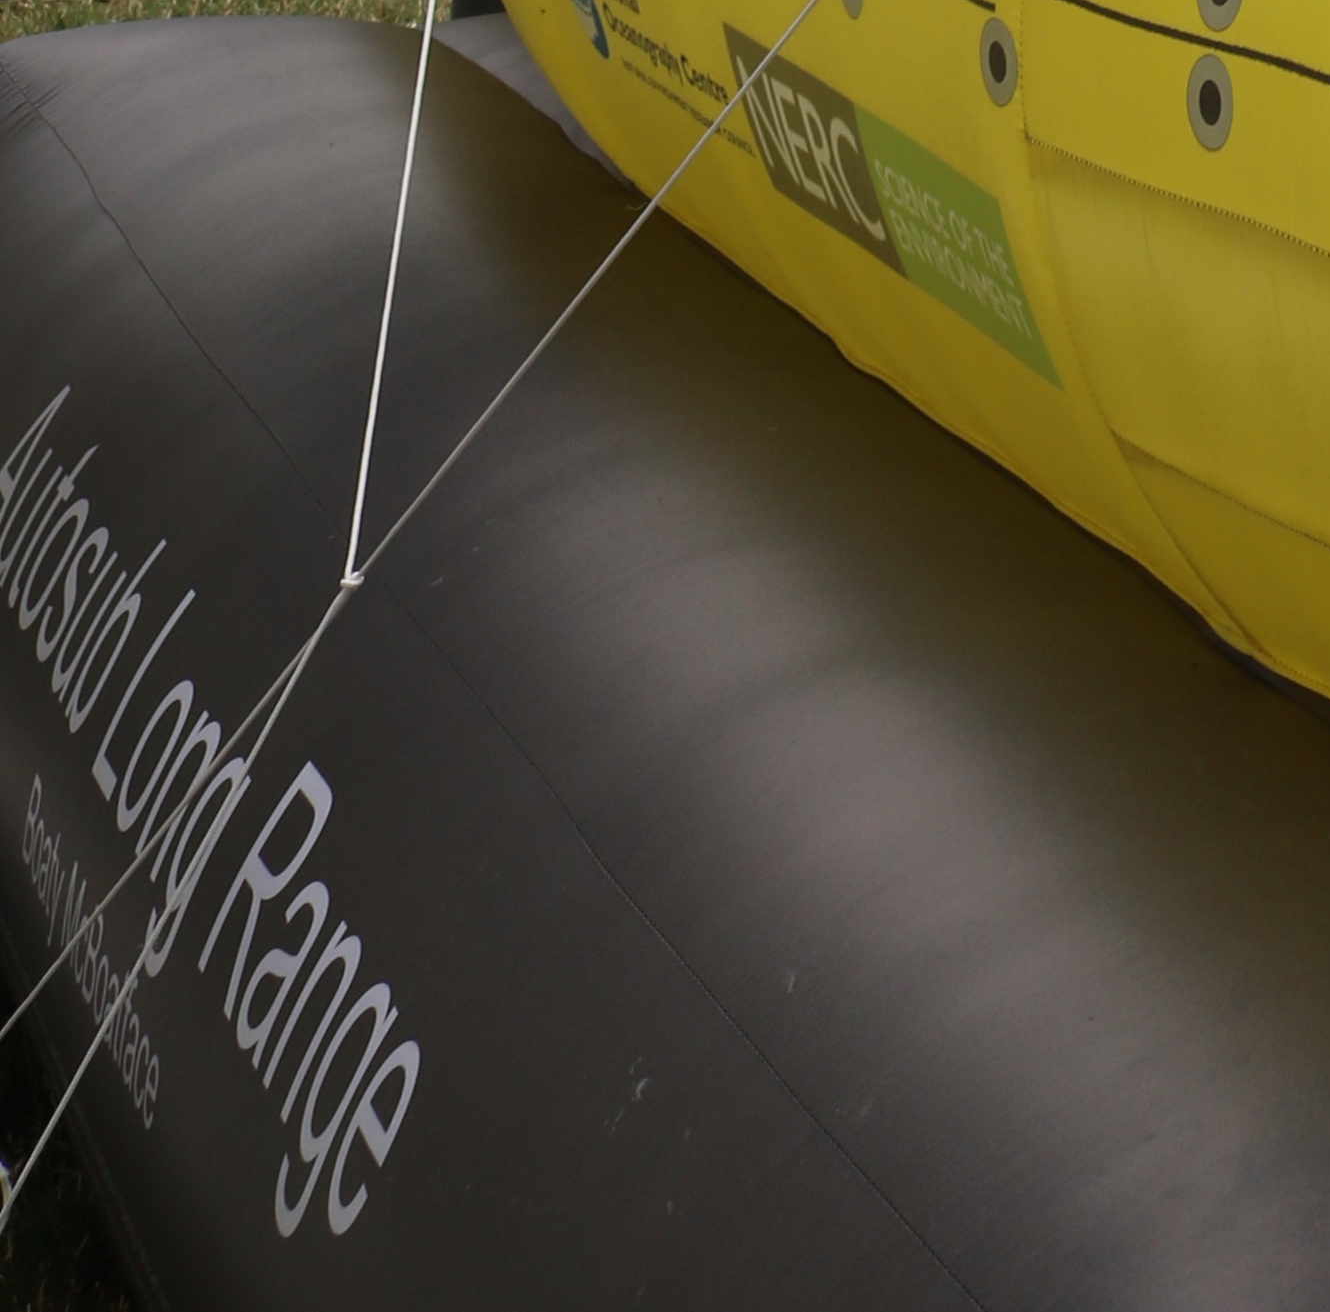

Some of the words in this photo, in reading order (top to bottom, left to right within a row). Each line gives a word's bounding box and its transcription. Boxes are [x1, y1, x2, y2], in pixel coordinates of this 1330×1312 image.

[736, 54, 887, 242] NERC
[874, 158, 950, 240] SCIENCE
[950, 208, 974, 256] OF
[973, 225, 1015, 288] THE
[889, 208, 1033, 341] ENVIRONMENT
[0, 384, 167, 735] Autosub
[91, 588, 252, 978] Long
[198, 760, 421, 1239] Range
[21, 774, 66, 948] Boaty
[60, 860, 160, 1130] McBoatface
